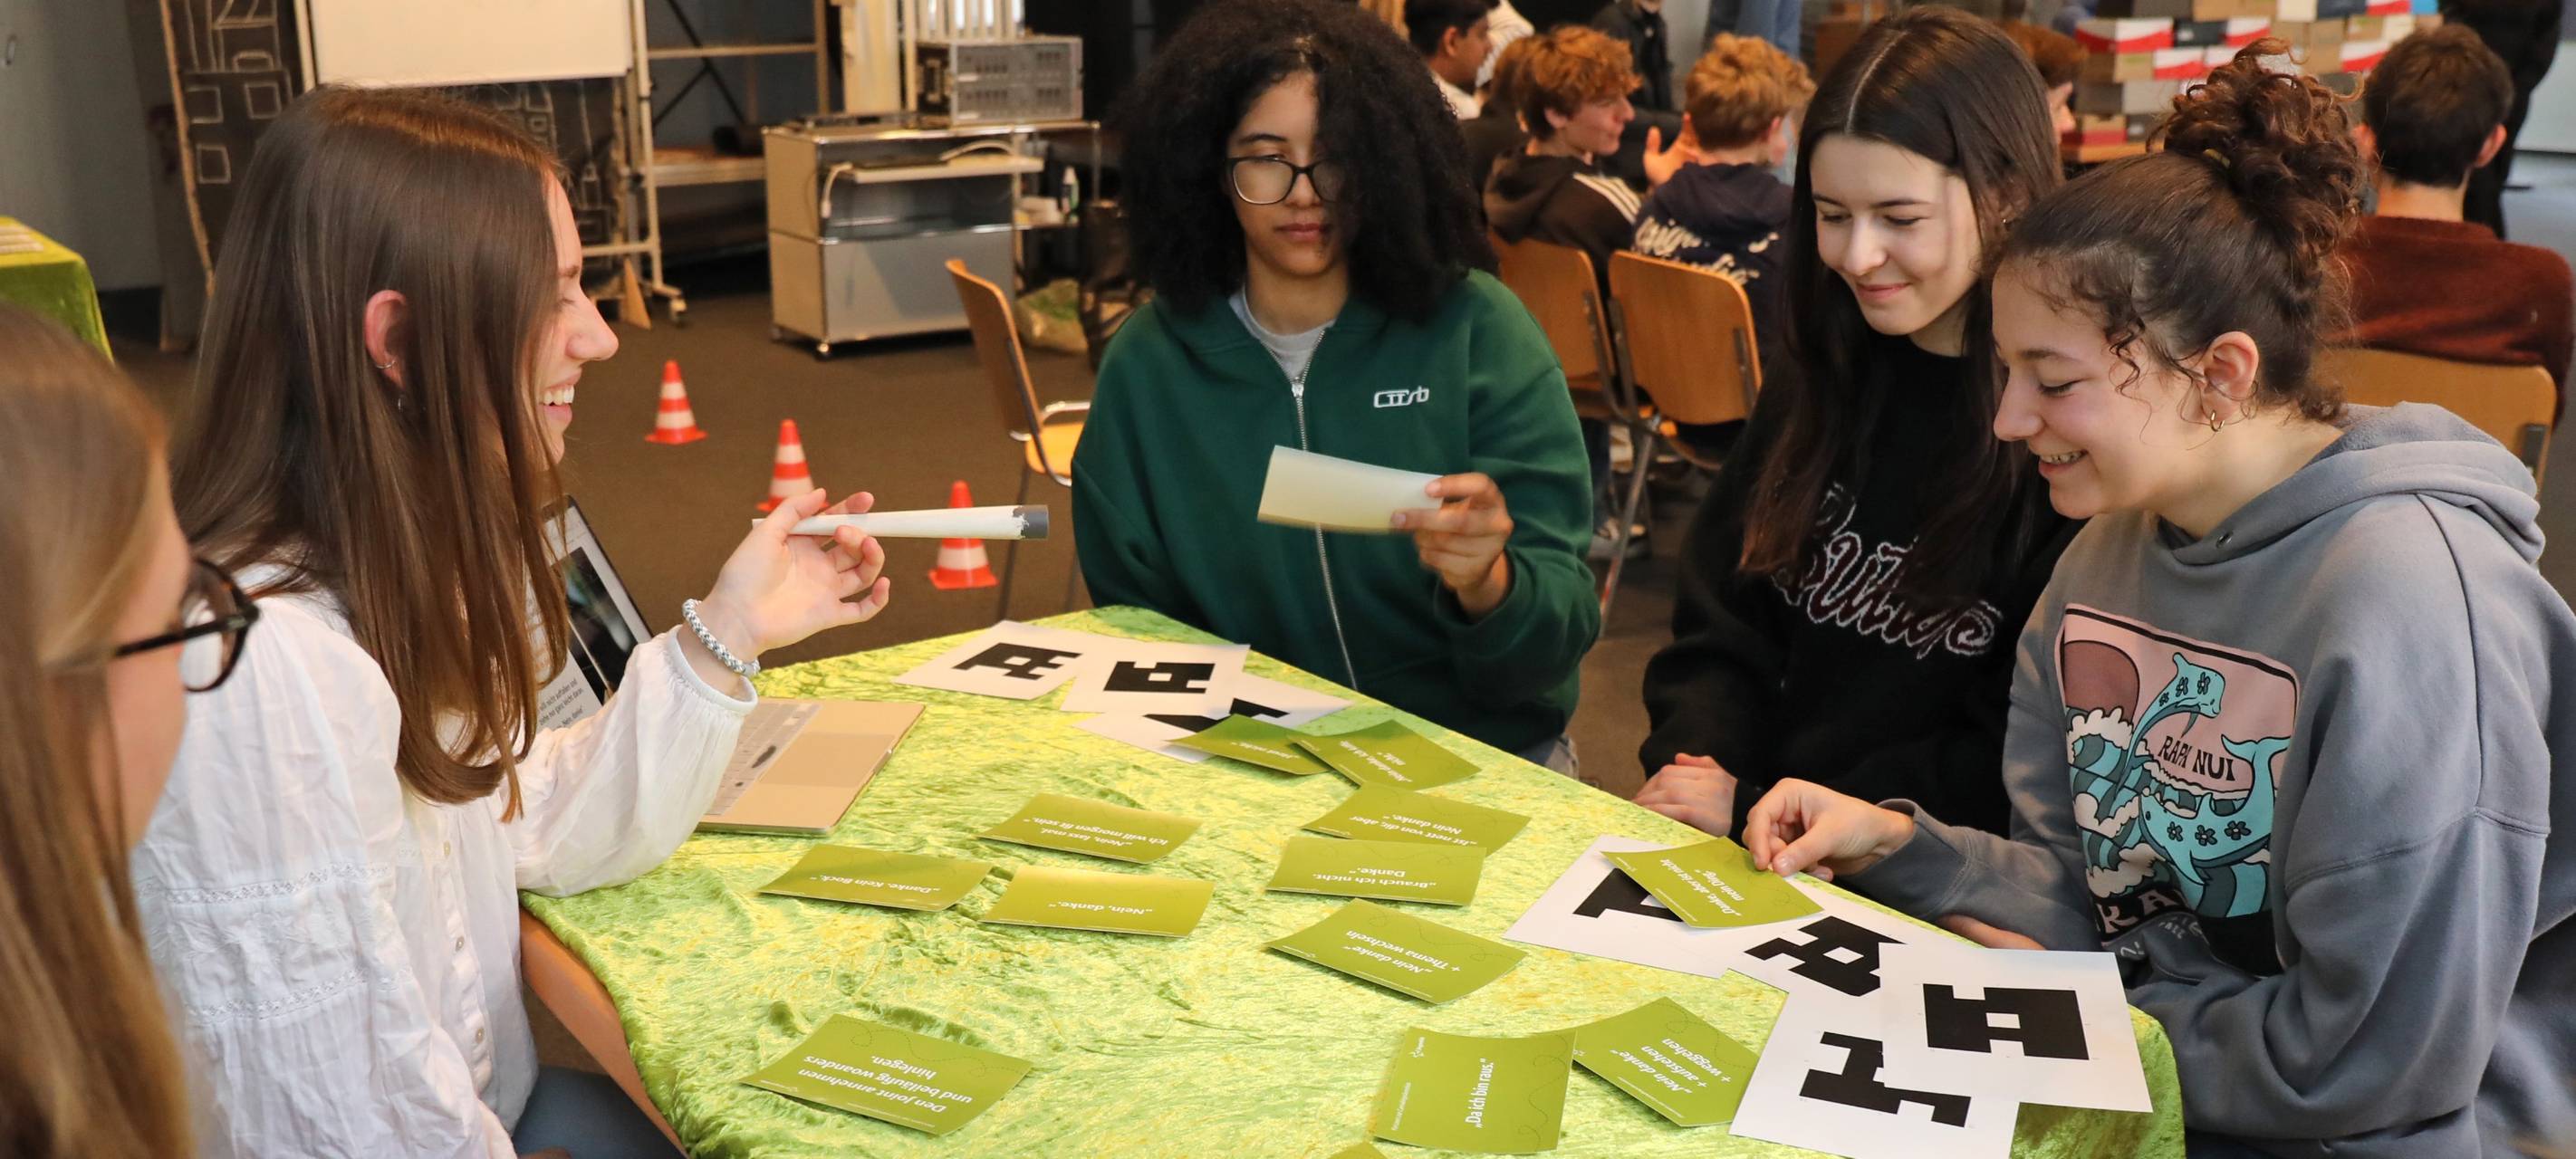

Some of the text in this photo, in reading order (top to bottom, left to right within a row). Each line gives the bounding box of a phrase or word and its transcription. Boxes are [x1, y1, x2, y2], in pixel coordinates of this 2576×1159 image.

[2192, 749, 2235, 781] NUI
[1349, 815, 1379, 825] aber
[1380, 821, 1400, 830] dir,
[1067, 832, 1091, 841] lass
[1075, 825, 1123, 838] morgen
[1123, 833, 1147, 841] will
[1401, 826, 1424, 837] von
[1424, 832, 1453, 842] nett
[1435, 824, 1462, 835] Nein
[1148, 838, 1168, 846] Ich
[1659, 858, 1682, 876] nicht
[855, 879, 885, 888] Kein
[1312, 872, 1437, 889] „Brauch ich nicht.
[1688, 882, 1710, 895] aber
[1721, 886, 1745, 901] mein
[1108, 905, 1153, 915] „Nein,
[1346, 930, 1405, 953] wechseln
[1342, 944, 1433, 973] „Nein danke“
[1405, 951, 1449, 971] Thema
[1641, 1046, 1699, 1081] aufstehen
[1662, 1039, 1722, 1077] weggehen
[870, 1055, 937, 1080] hinlegen.
[1610, 1049, 1693, 1094] „Nein danke“
[798, 1068, 876, 1093] annehmen
[803, 1055, 973, 1105] und beiläufig woanders
[1476, 1077, 1489, 1093] bin
[875, 1087, 914, 1105] Joint
[1469, 1092, 1485, 1108] ich
[914, 1098, 947, 1114] Den
[1465, 1107, 1483, 1129] „Da
